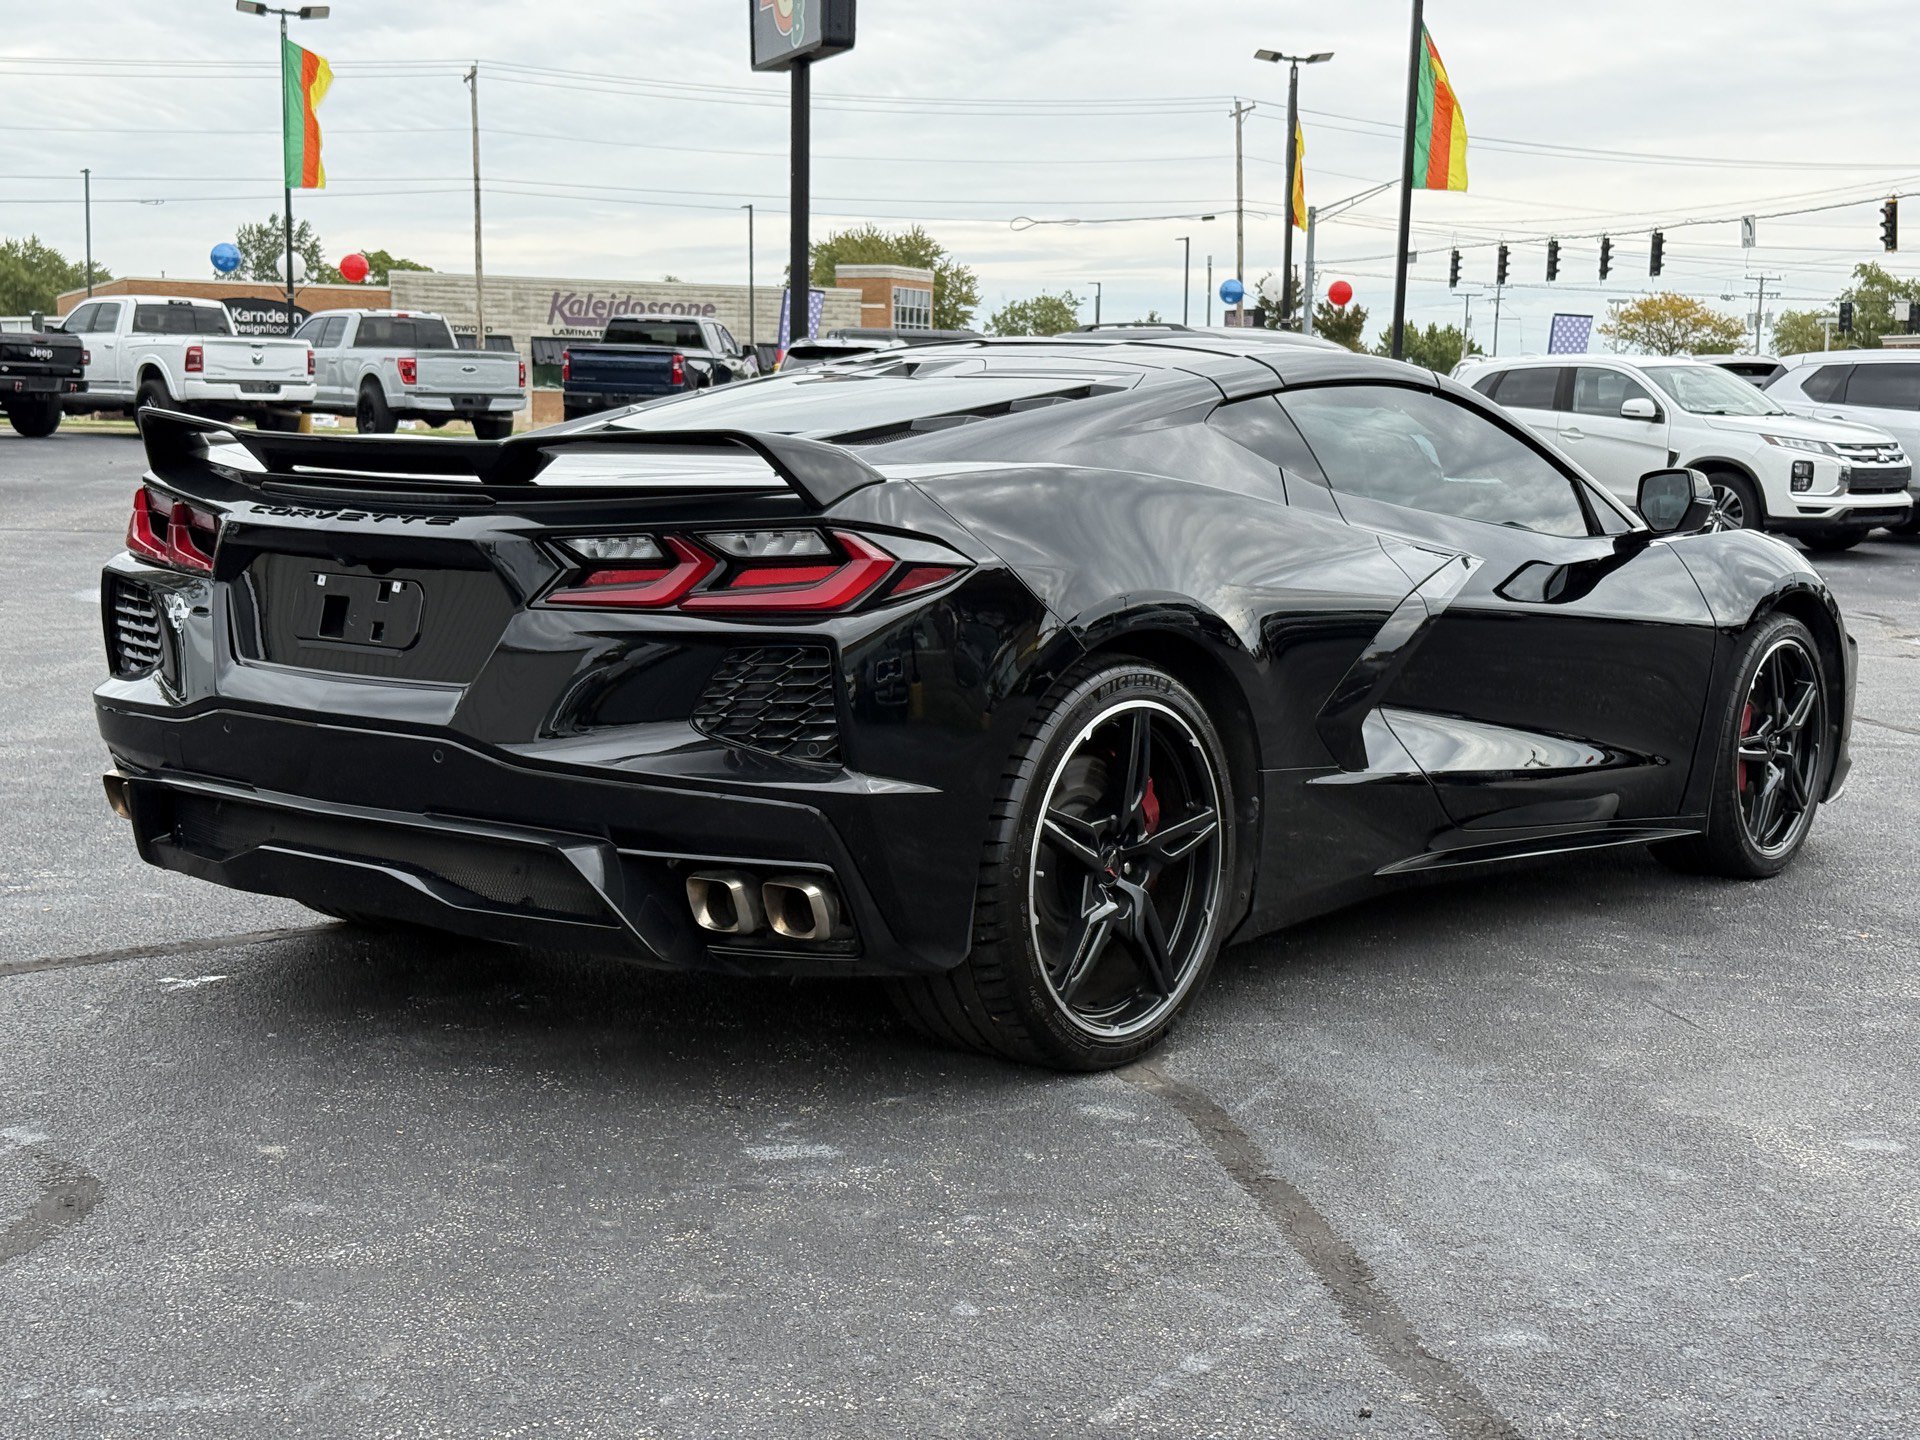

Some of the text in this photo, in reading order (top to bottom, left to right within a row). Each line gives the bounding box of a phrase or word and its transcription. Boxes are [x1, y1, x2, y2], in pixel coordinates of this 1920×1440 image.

[547, 292, 717, 326] Kaleidoscope
[30, 347, 53, 360] Jeep
[249, 505, 460, 526] CORVETTE
[1099, 674, 1171, 700] MICHELIN
